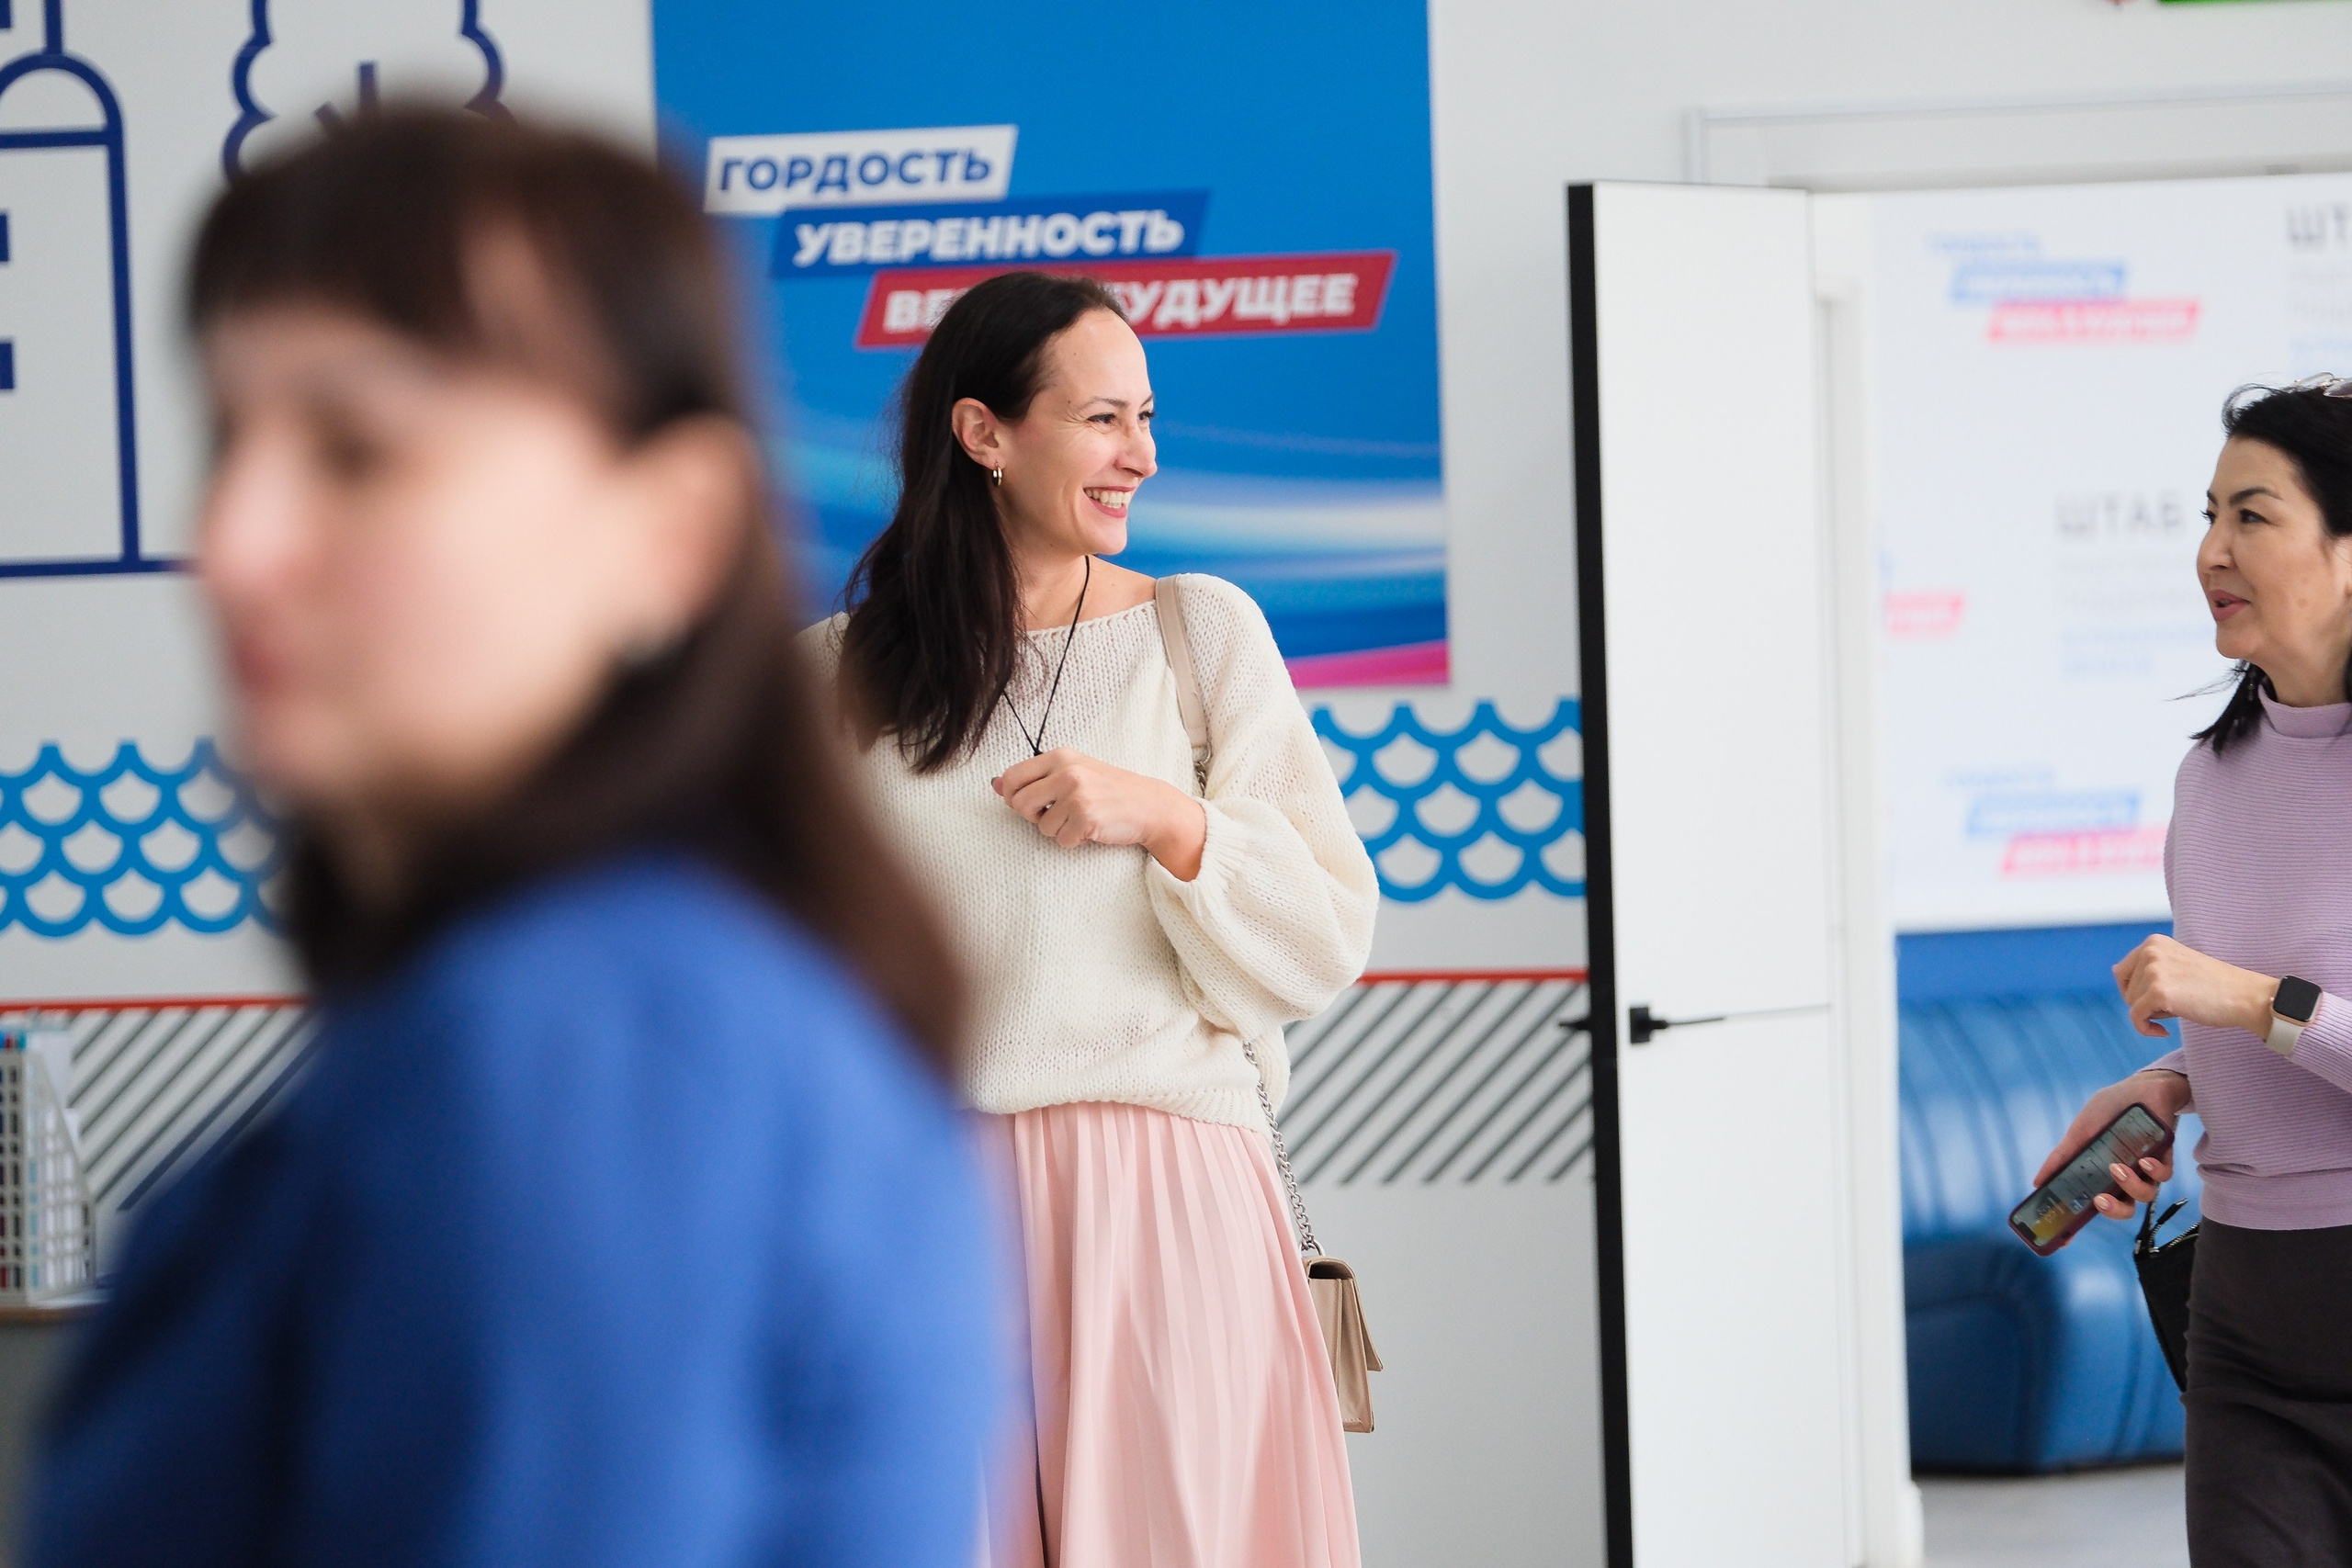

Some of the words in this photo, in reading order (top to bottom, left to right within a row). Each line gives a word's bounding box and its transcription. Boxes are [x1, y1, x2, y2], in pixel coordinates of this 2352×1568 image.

[720, 146, 990, 194] ГОРДОСТЬ
[792, 209, 1185, 269] УВЕРЕННОСТЬ
[1107, 273, 1358, 329] УДУЩЕЕ
